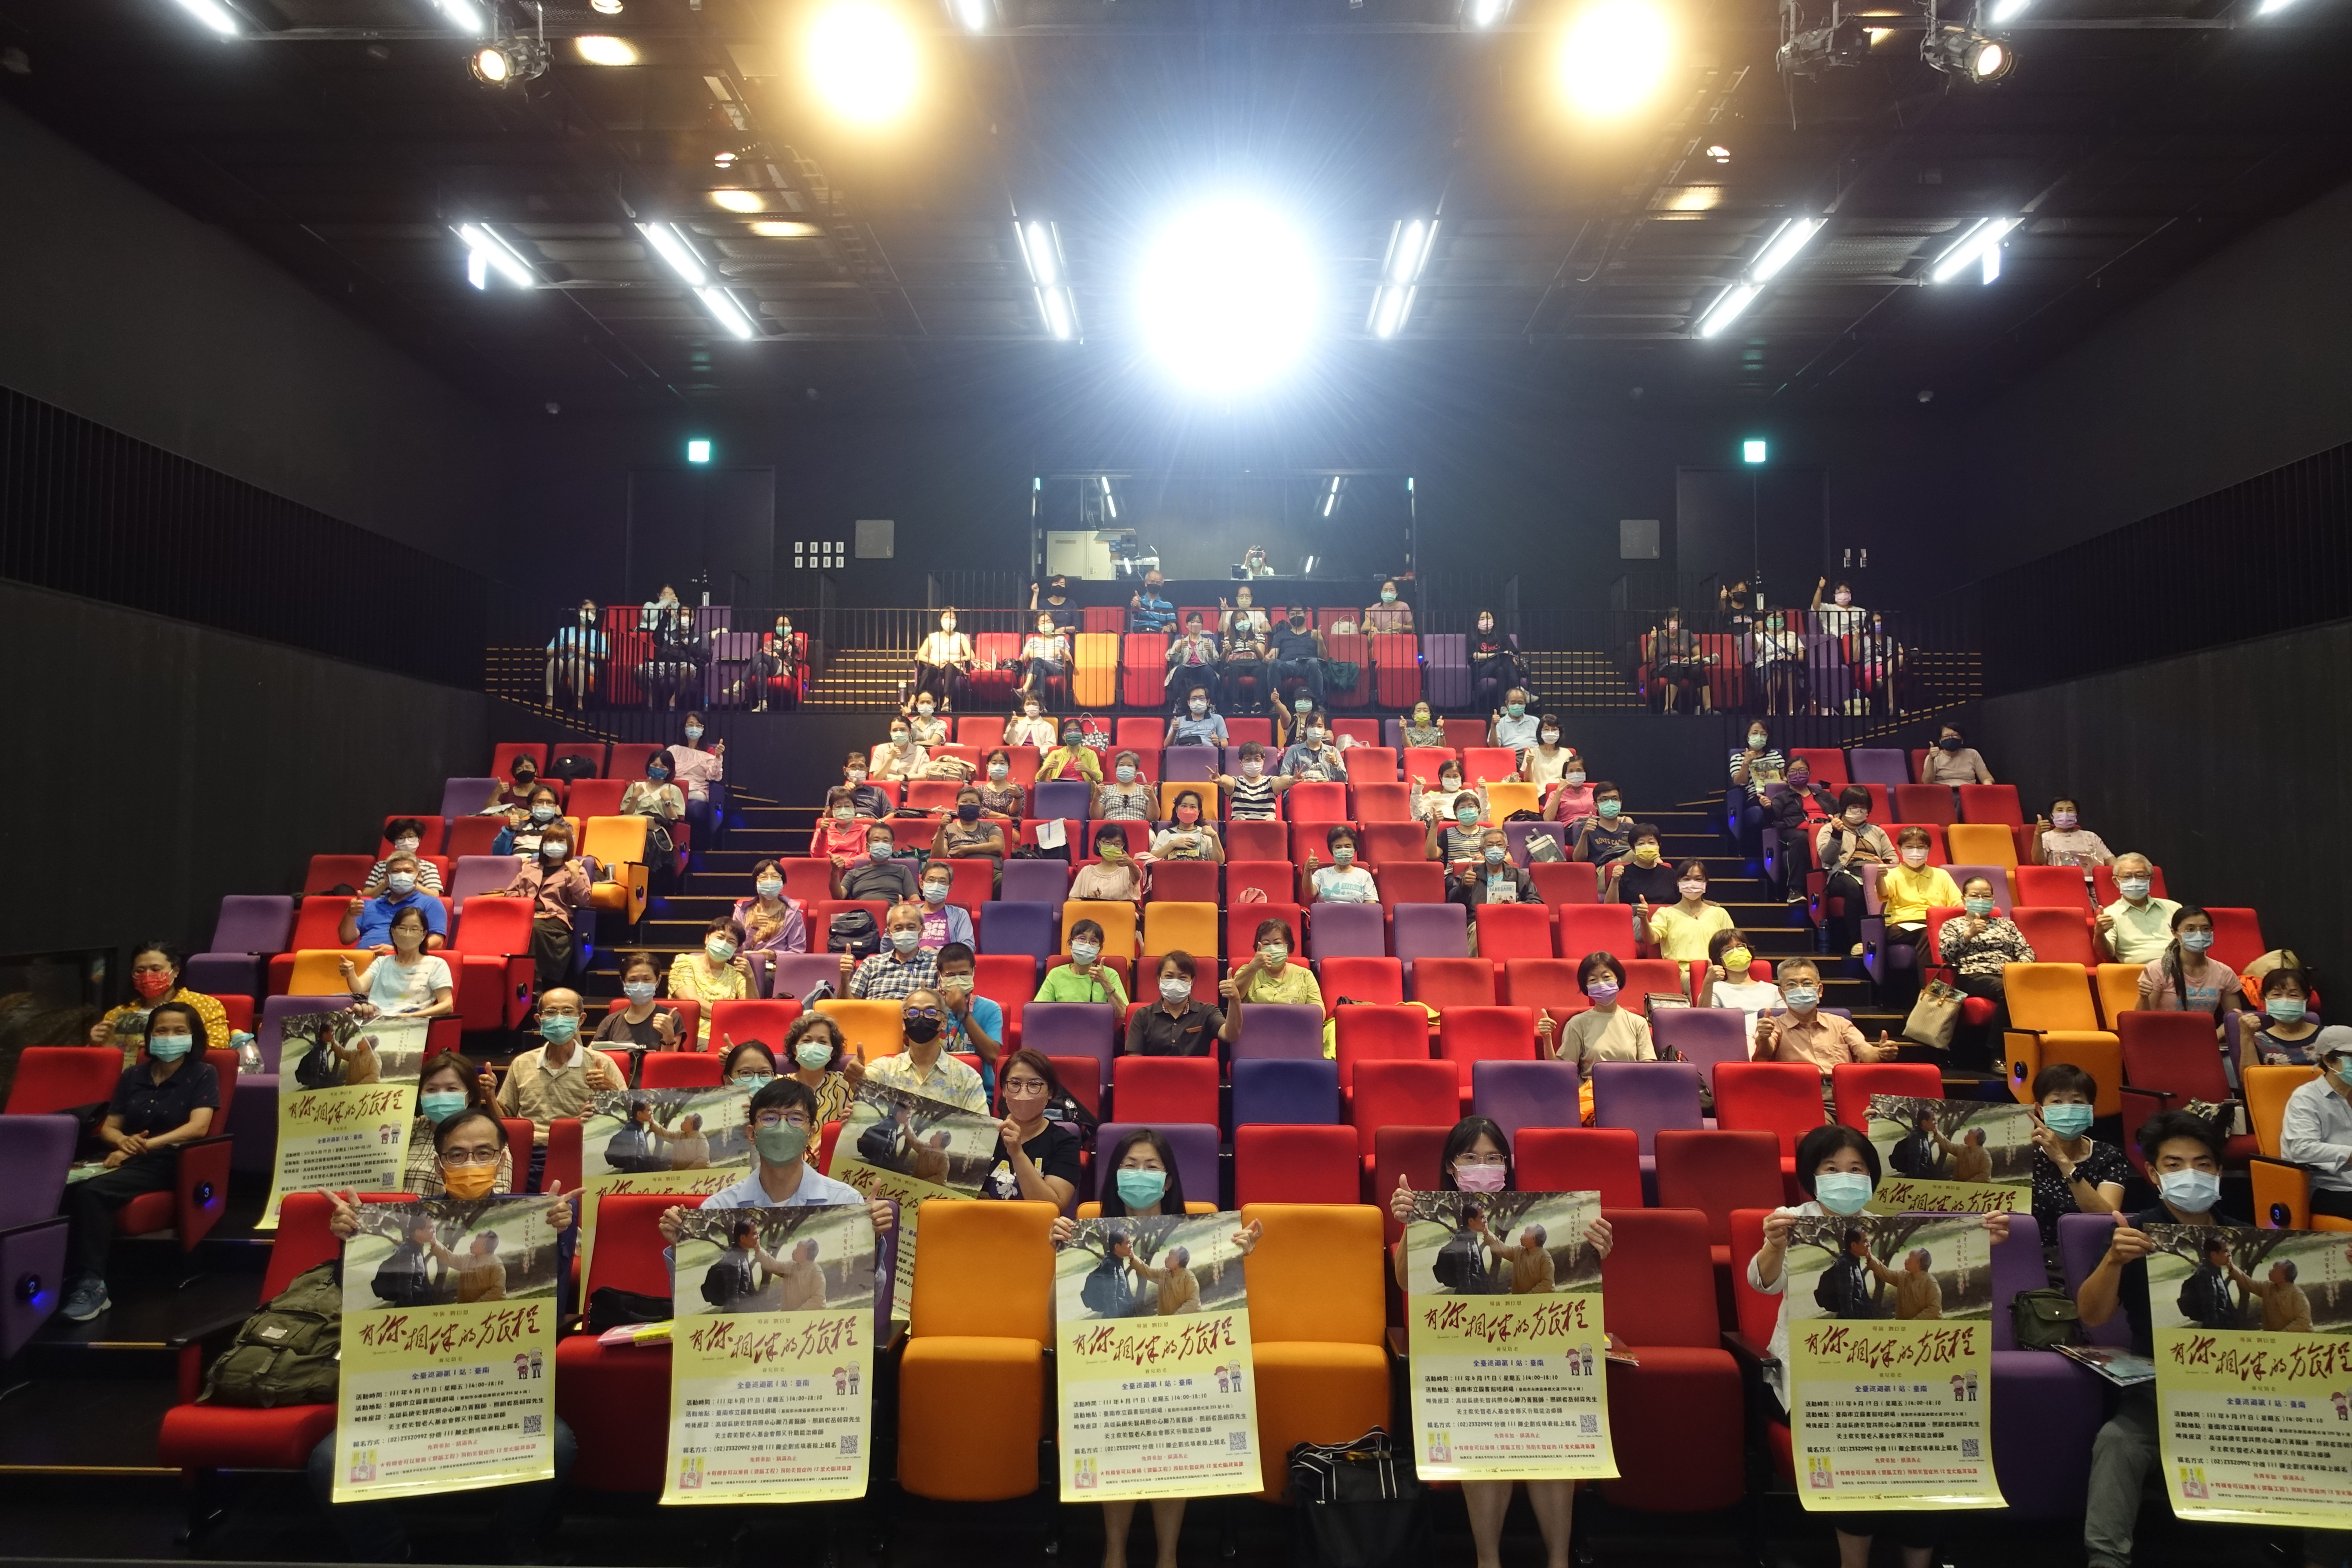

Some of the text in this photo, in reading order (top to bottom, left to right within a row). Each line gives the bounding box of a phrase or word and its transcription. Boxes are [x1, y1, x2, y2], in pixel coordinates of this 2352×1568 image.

[205, 1187, 209, 1197] 3
[2274, 1210, 2279, 1219] 3
[29, 1281, 35, 1293] 2
